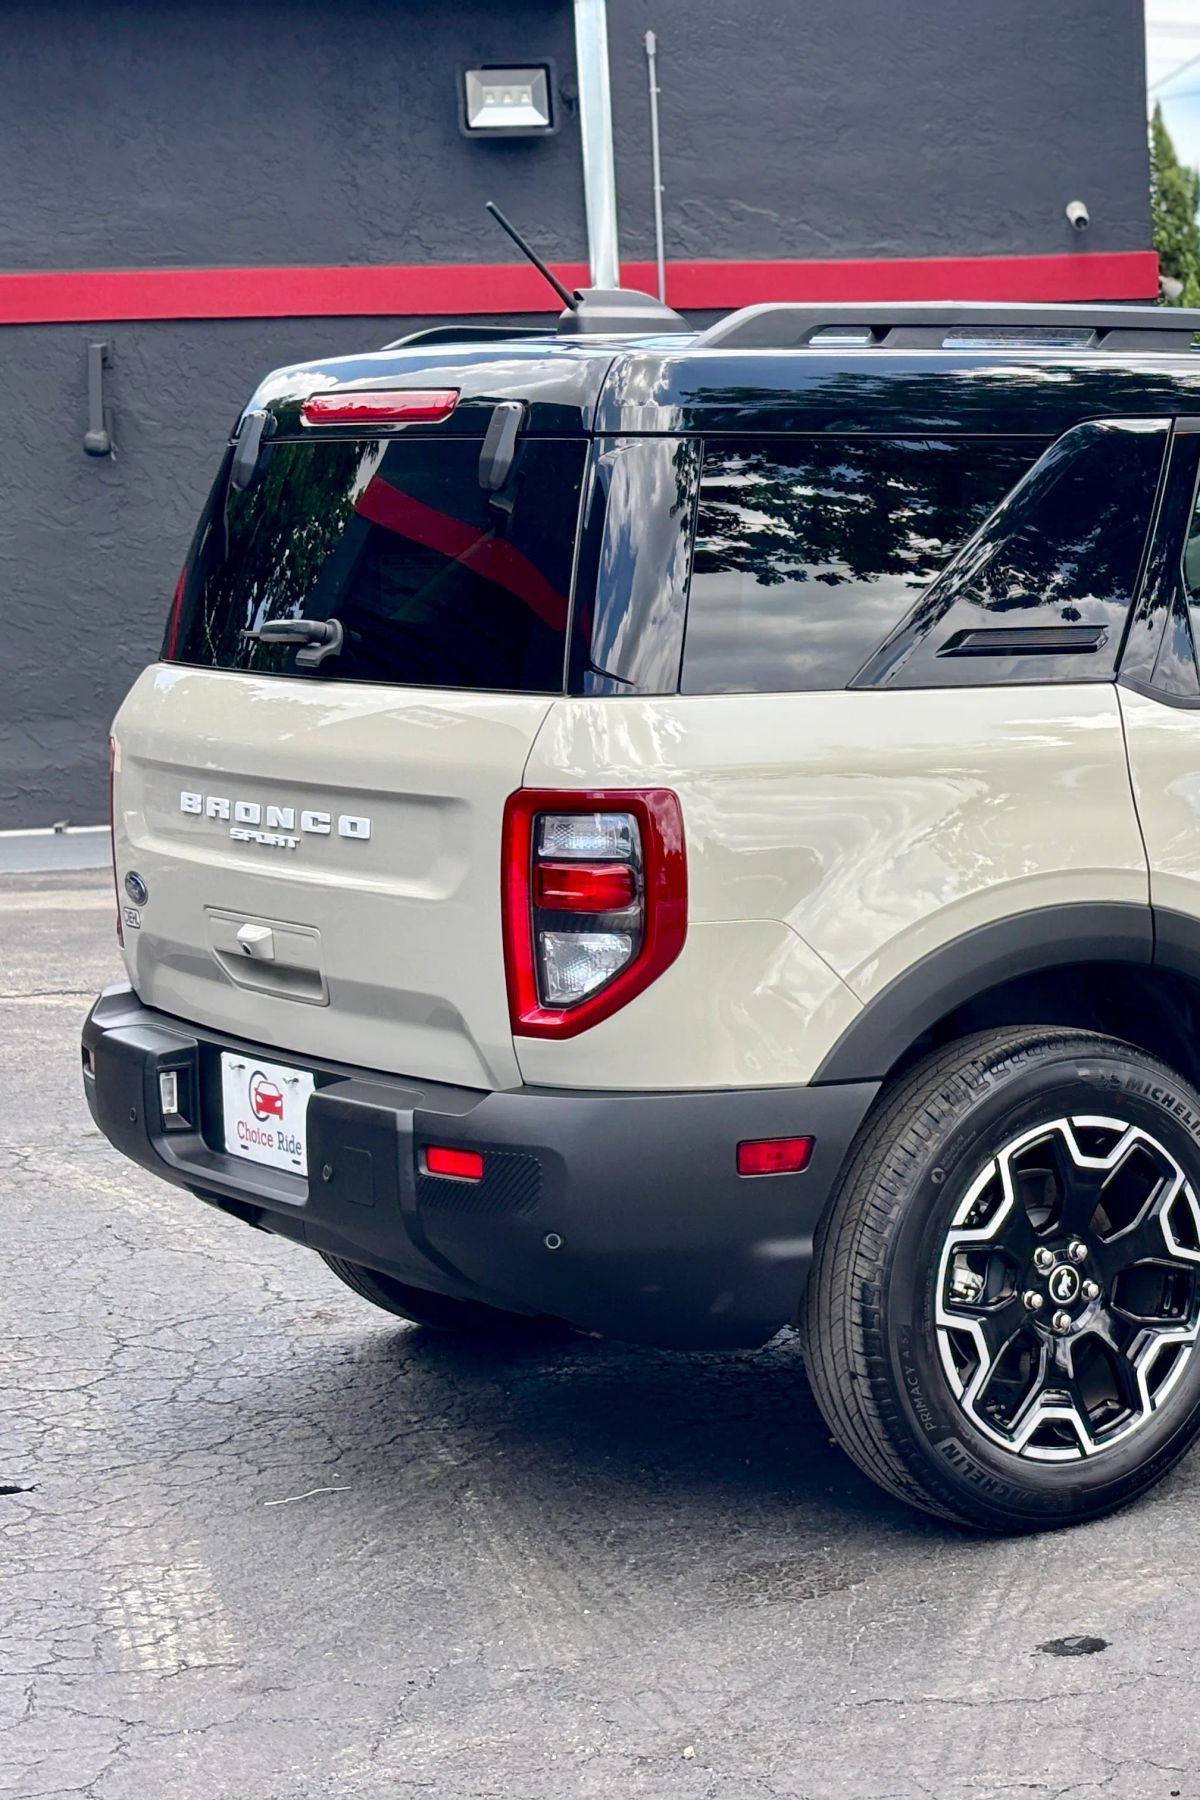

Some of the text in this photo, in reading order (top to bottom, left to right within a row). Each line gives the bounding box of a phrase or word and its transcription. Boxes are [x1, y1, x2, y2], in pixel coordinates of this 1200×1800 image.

[180, 791, 372, 840] BRONCO
[229, 828, 301, 849] SPORT
[237, 1120, 302, 1156] Choice Ride
[908, 1366, 937, 1432] PRIMACY
